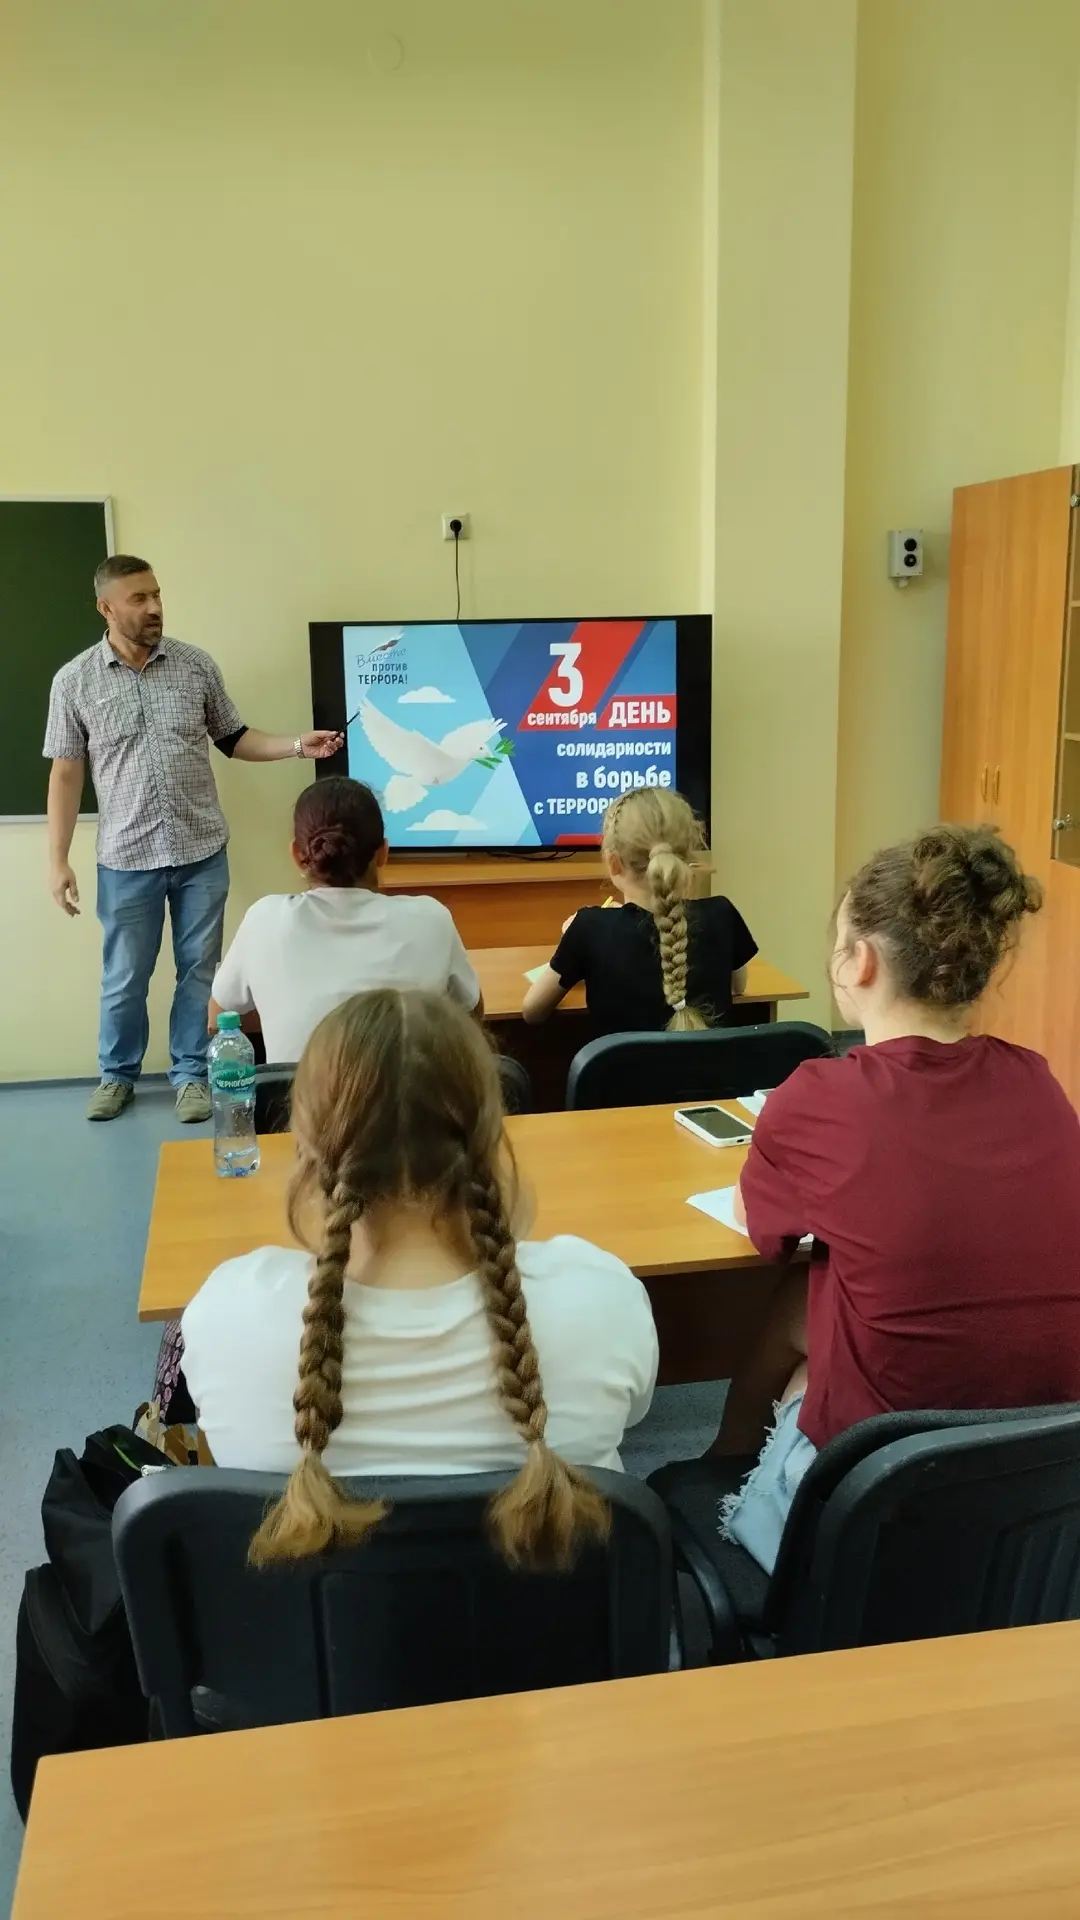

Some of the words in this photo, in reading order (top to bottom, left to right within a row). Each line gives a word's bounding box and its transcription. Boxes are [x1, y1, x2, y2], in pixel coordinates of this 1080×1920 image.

[356, 648, 407, 668] Вместе
[372, 663, 408, 675] против
[548, 643, 583, 707] 3
[358, 674, 408, 685] ТЕРРОРА!
[527, 709, 597, 728] сентября
[609, 701, 671, 727] ДЕНЬ
[557, 742, 671, 759] солидарности
[576, 771, 589, 788] в
[593, 765, 671, 792] борьбе
[533, 802, 544, 815] с
[547, 797, 616, 814] ТЕРРОР
